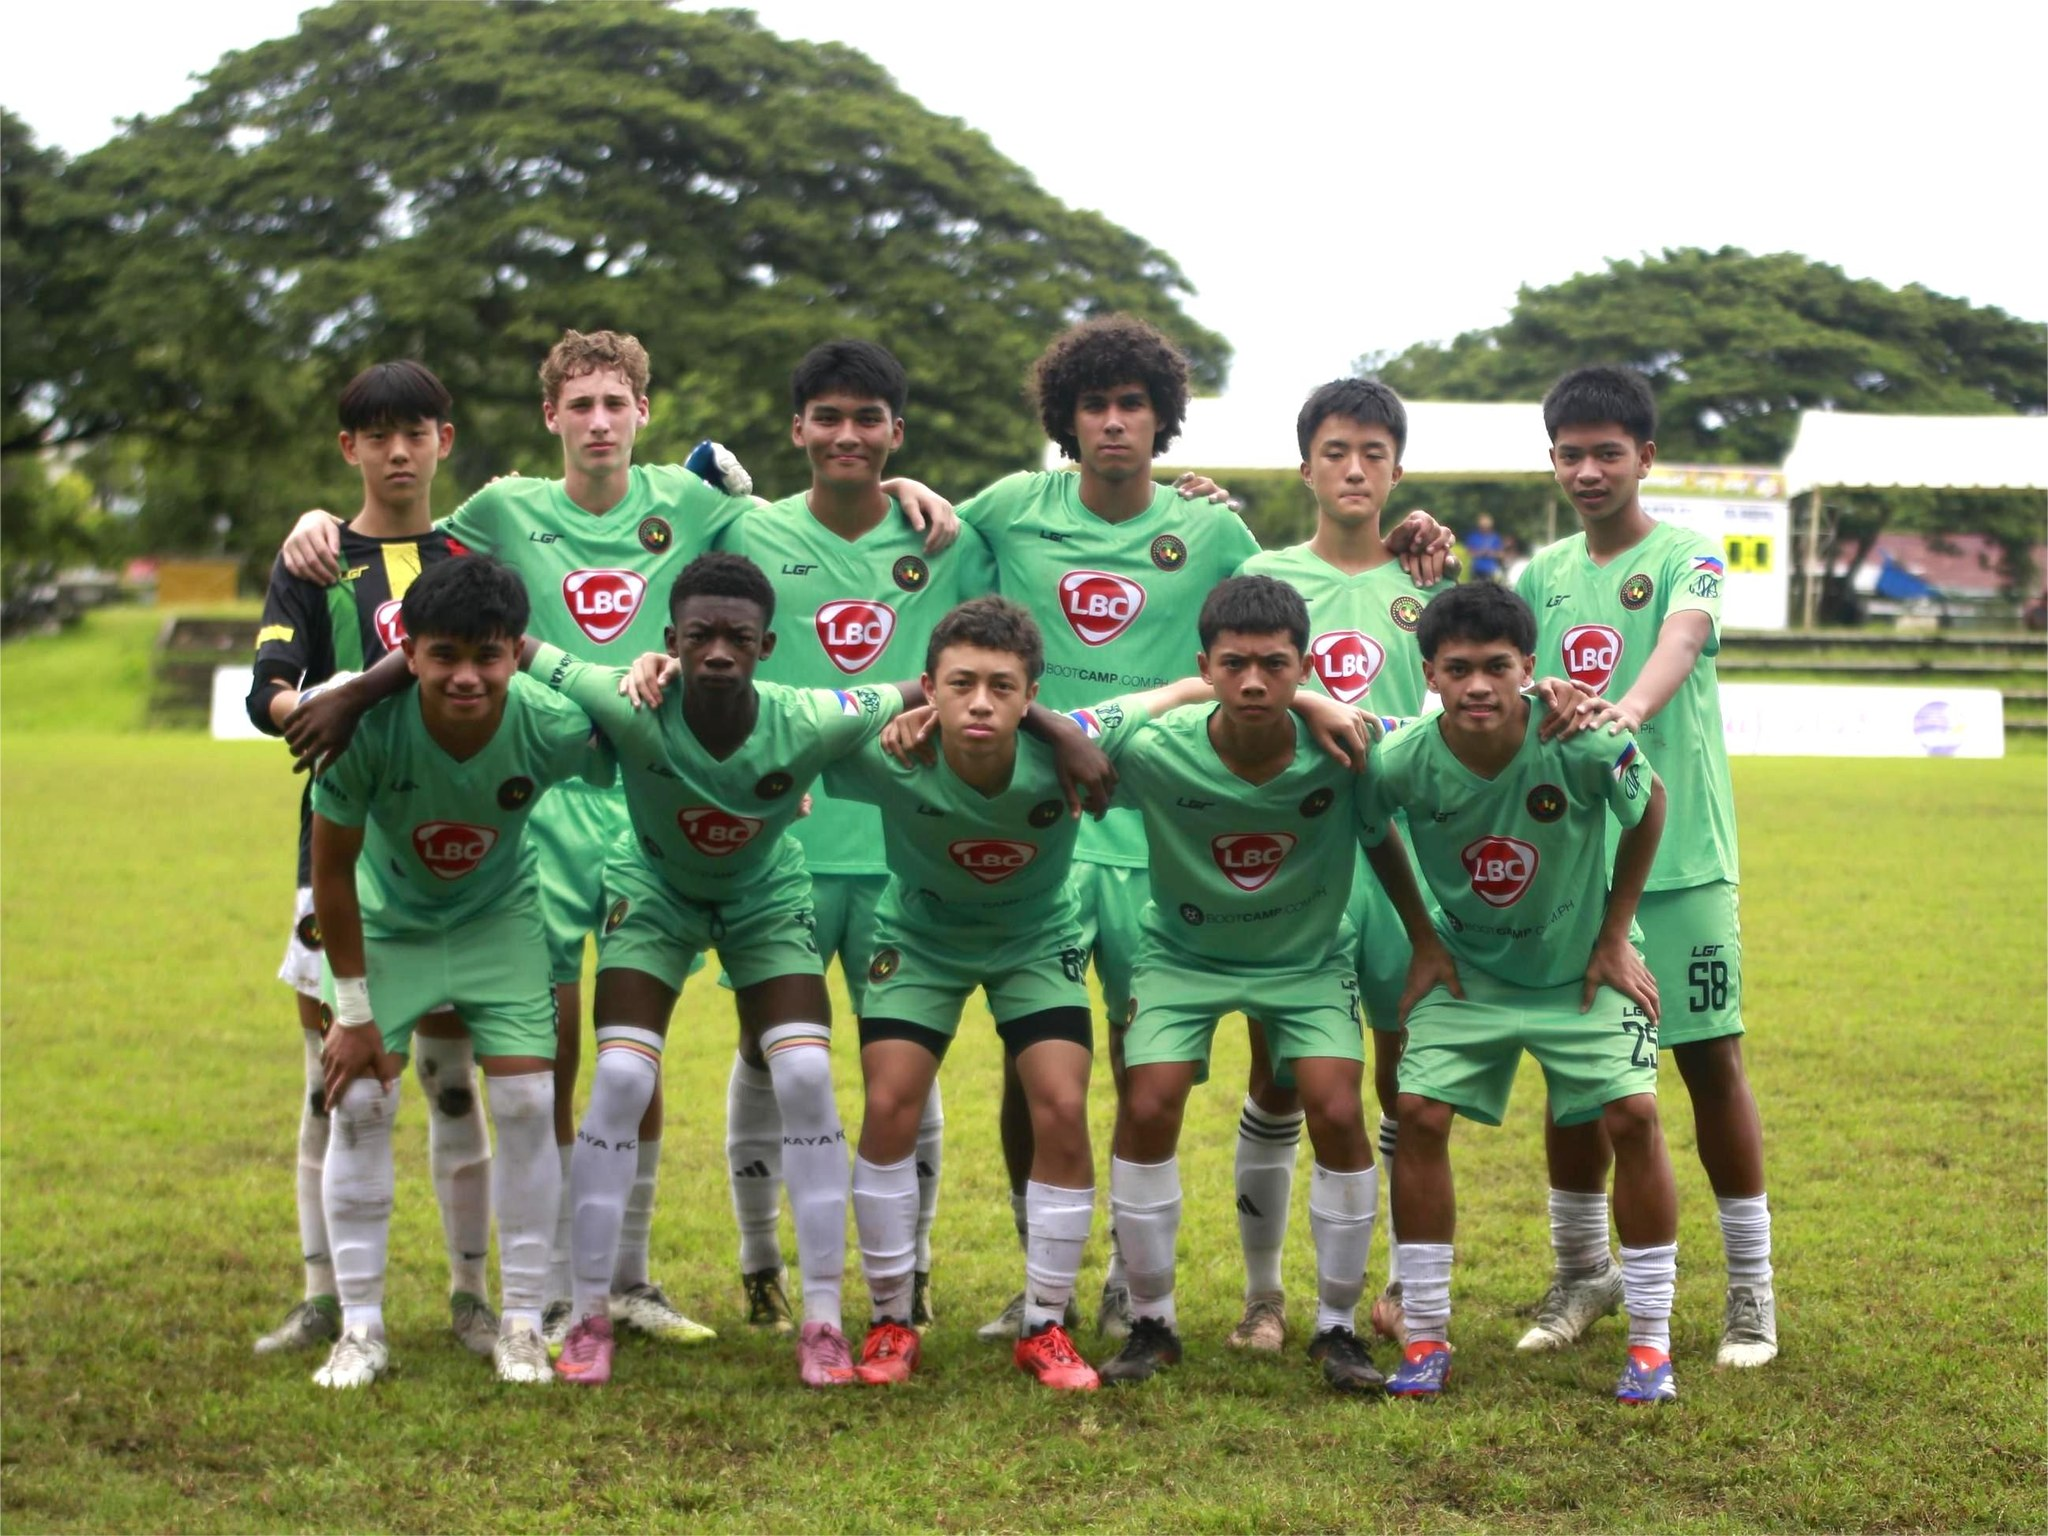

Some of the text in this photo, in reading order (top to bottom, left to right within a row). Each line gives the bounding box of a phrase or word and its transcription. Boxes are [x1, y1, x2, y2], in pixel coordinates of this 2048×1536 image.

[576, 590, 633, 615] LBC
[1070, 590, 1129, 620] LBC
[828, 621, 882, 646] LBC
[1324, 653, 1369, 679] LBC
[1570, 647, 1613, 673] LBC
[425, 841, 482, 862] LBC
[963, 853, 1023, 868] LBC
[1225, 847, 1281, 868] LBC
[1474, 857, 1522, 882] LBC
[1689, 960, 1728, 1013] 58
[783, 1135, 833, 1147] KAYA
